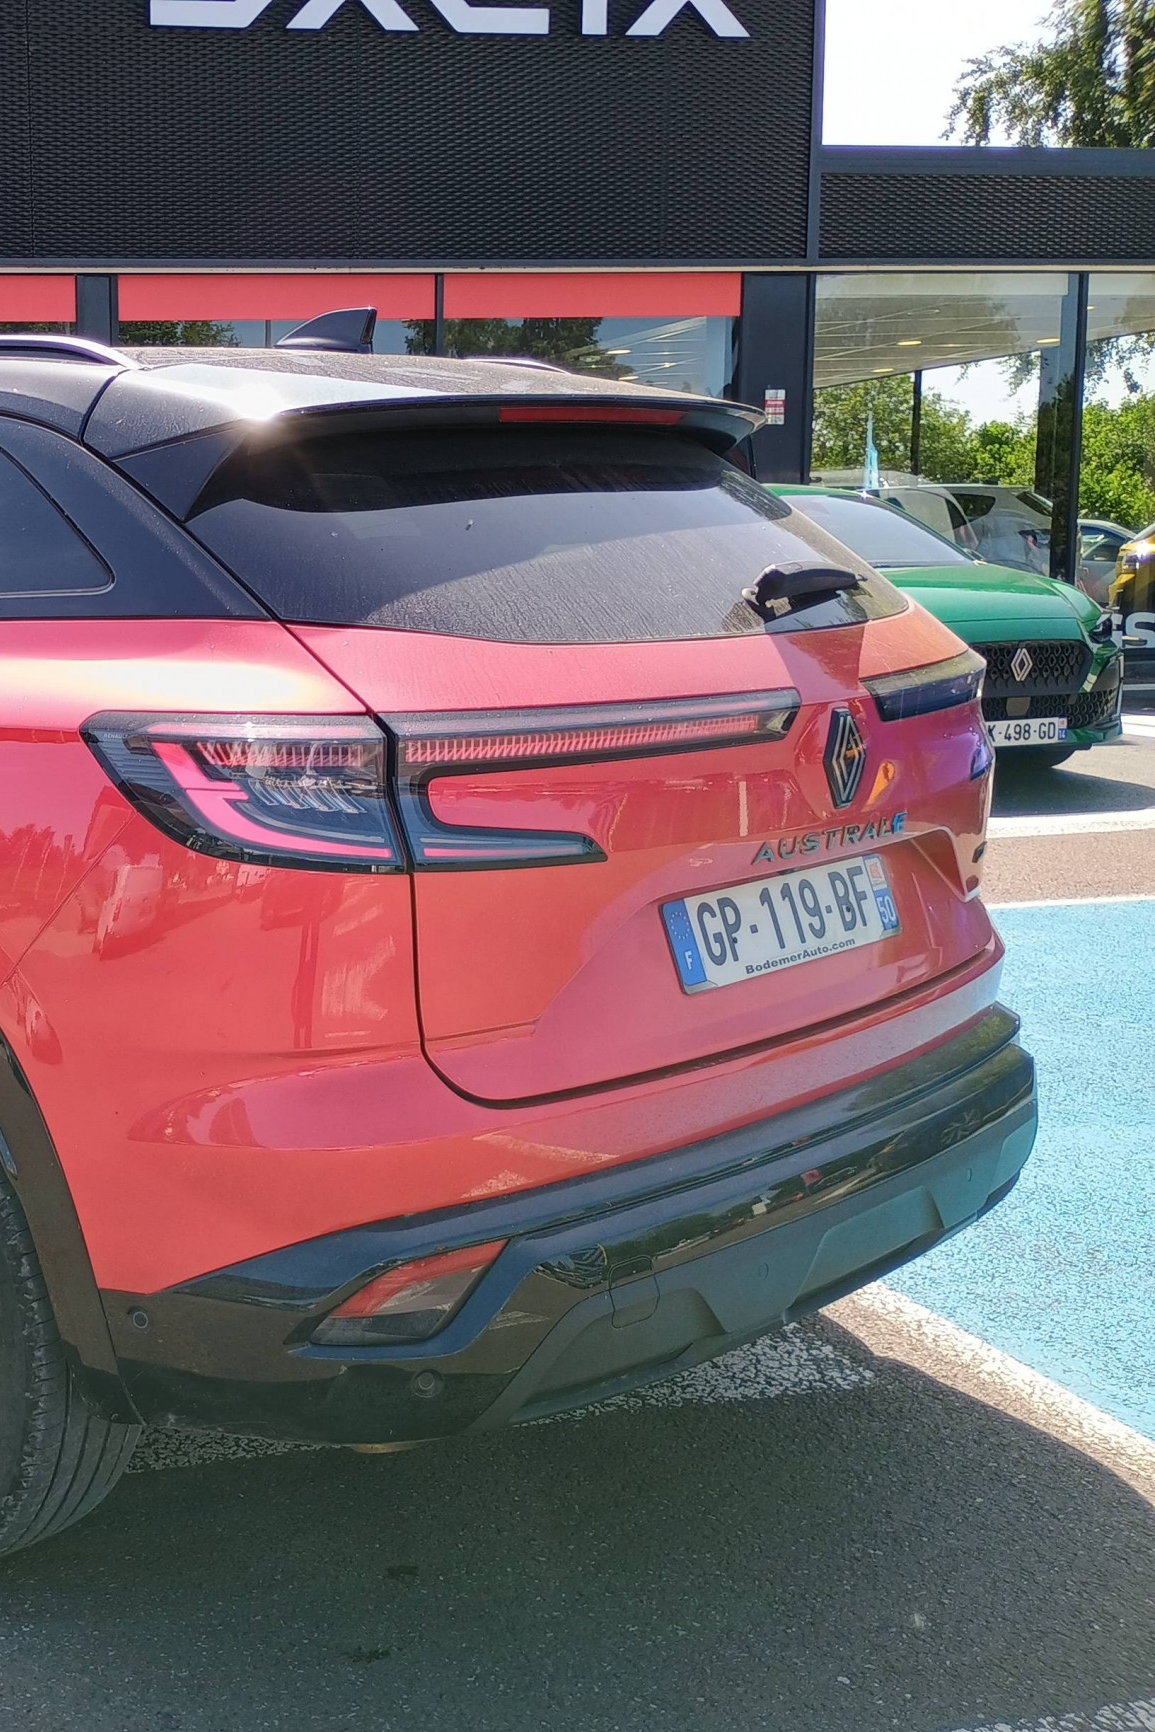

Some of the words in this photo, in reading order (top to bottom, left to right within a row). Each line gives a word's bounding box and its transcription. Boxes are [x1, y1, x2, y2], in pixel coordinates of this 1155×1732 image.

[987, 721, 1057, 743] K-498-GD
[696, 865, 868, 967] GP-119-BF
[876, 894, 897, 924] 50
[683, 950, 693, 971] F
[745, 937, 856, 975] BodemerAuto.com
